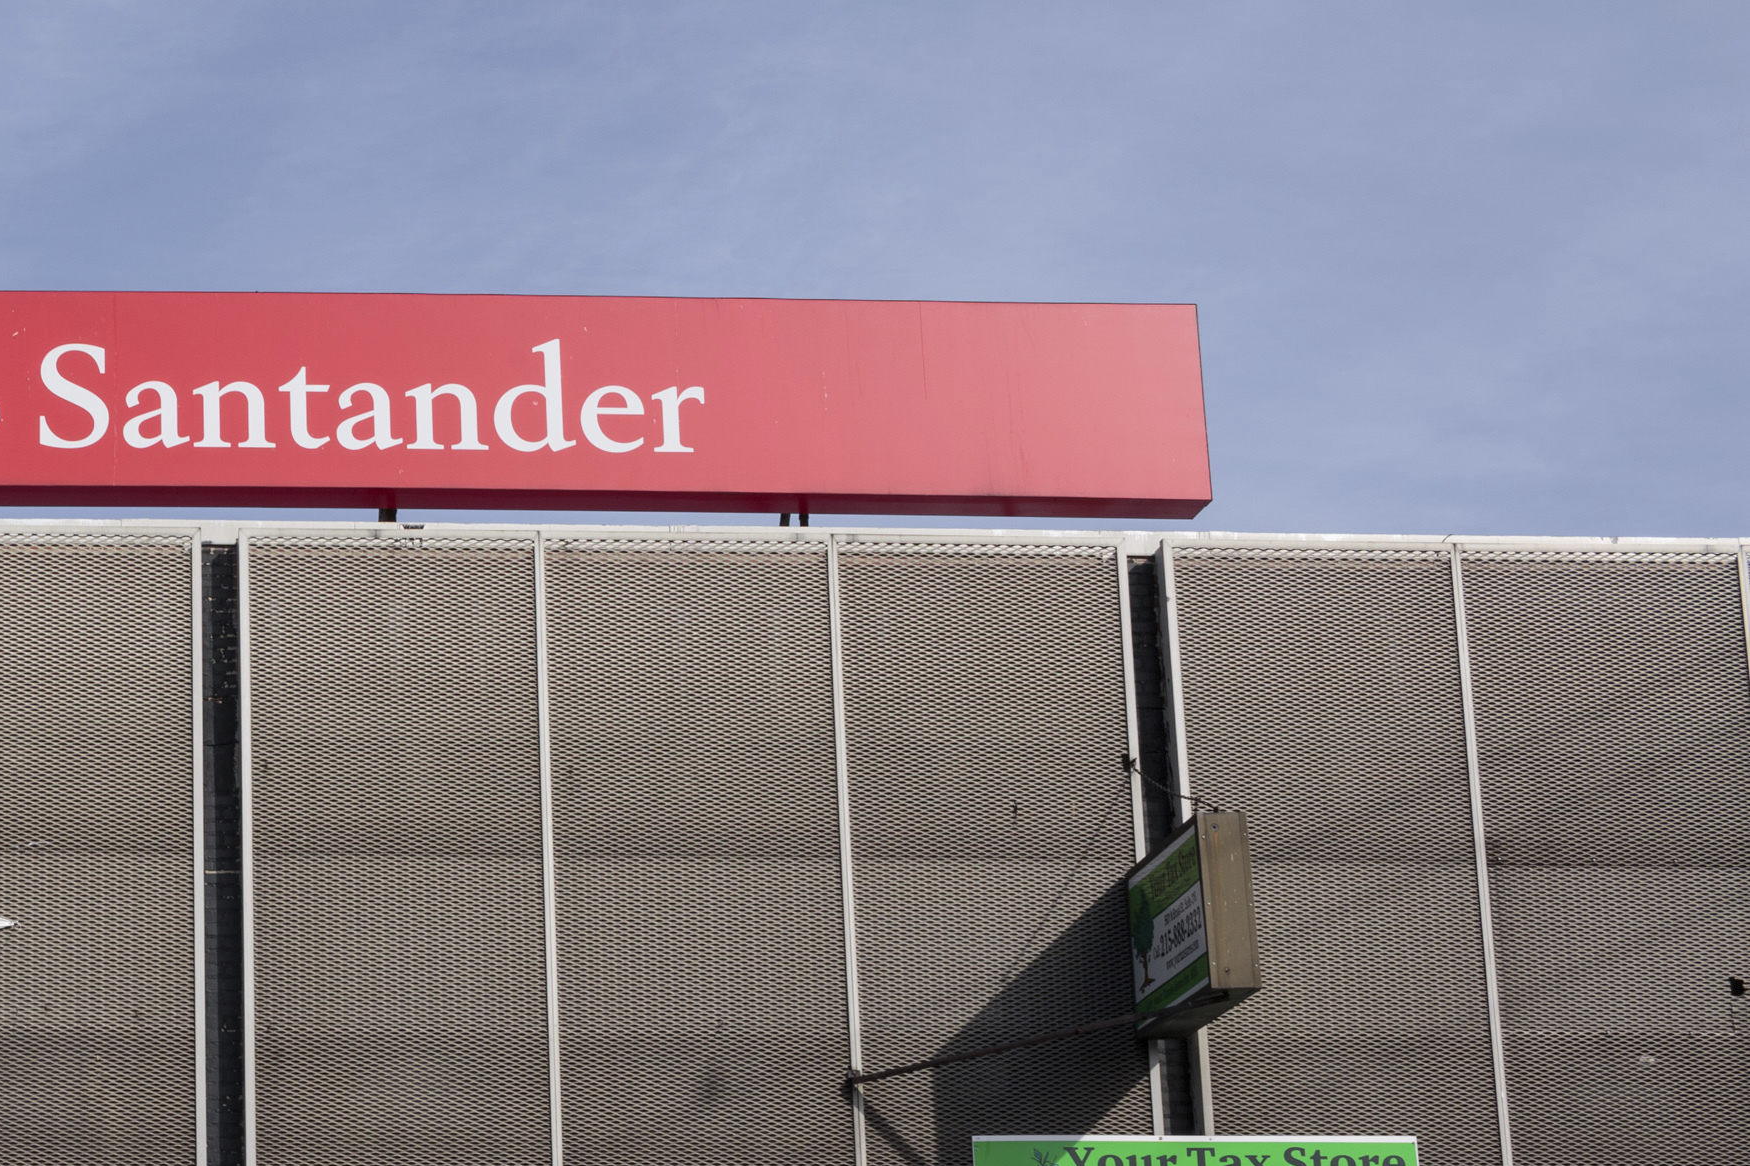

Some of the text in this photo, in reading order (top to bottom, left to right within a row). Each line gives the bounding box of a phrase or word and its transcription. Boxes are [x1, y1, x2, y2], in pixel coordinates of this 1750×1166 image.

[39, 338, 705, 453] Santander
[1177, 847, 1196, 876] Store
[1160, 906, 1202, 958] 215-888-2332
